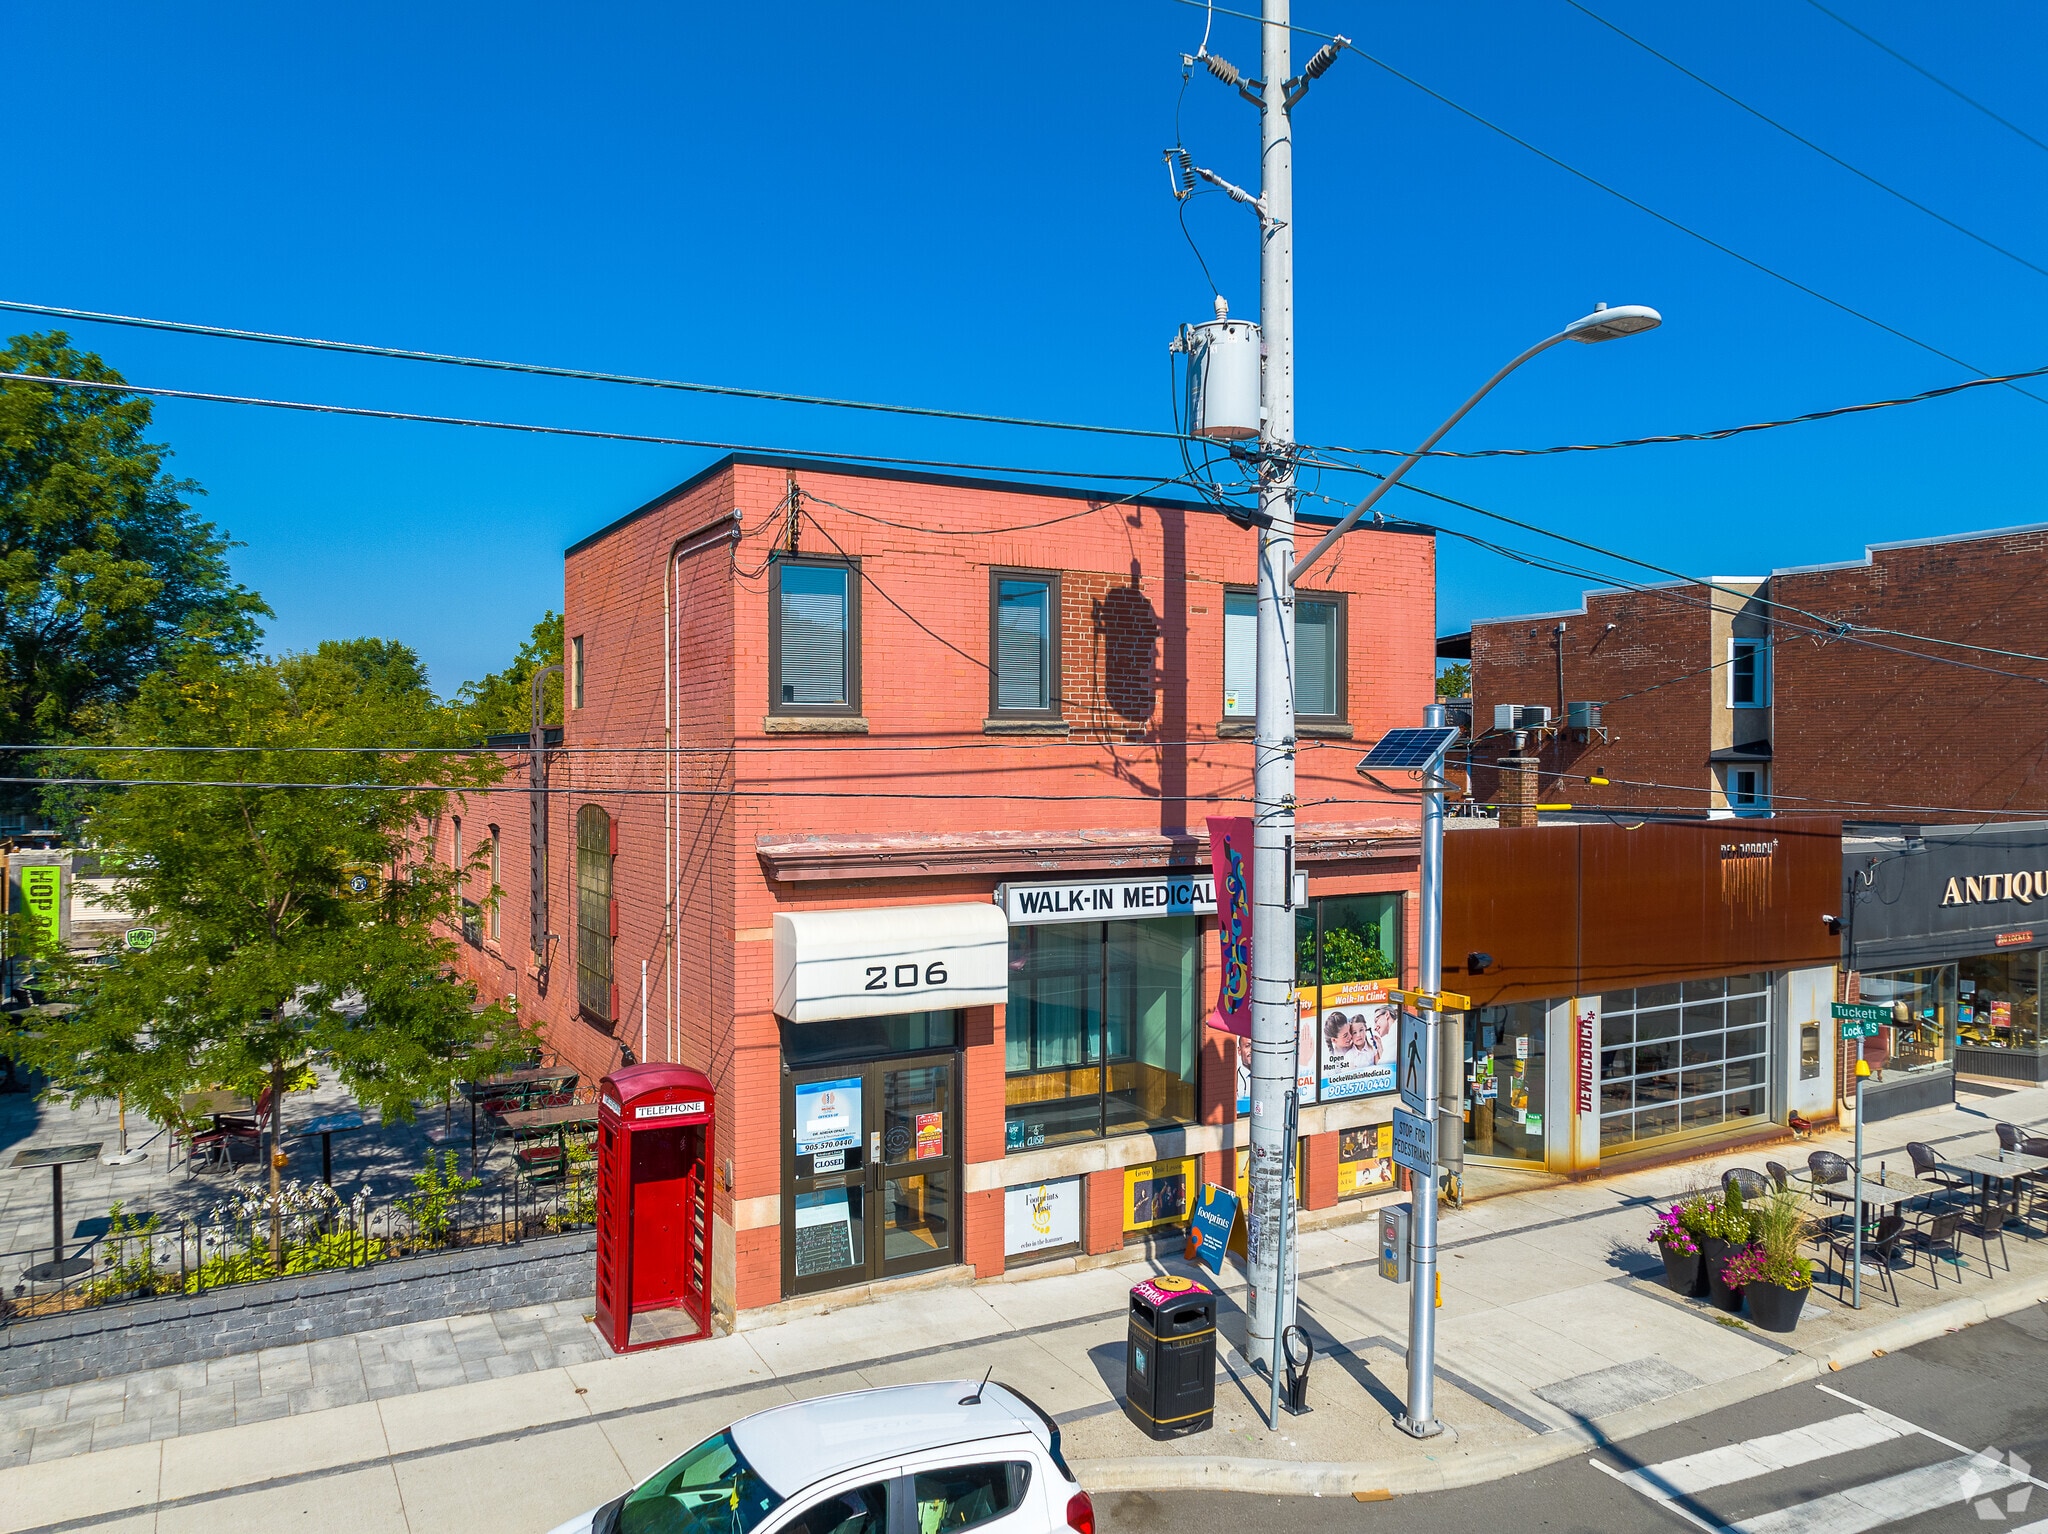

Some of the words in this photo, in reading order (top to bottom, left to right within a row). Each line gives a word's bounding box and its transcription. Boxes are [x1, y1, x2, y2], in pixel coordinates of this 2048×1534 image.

[30, 870, 53, 911] HOP
[1019, 888, 1113, 914] WALK-IN
[1123, 883, 1217, 909] MEDICAL
[864, 961, 948, 990] 206
[1342, 983, 1370, 994] Medical
[1373, 982, 1378, 990] &
[1335, 994, 1365, 1005] Walk-In
[1366, 990, 1386, 1002] Clinic
[1836, 1005, 1878, 1020] Tuckett
[1871, 1022, 1877, 1034] S
[1329, 1055, 1344, 1063] Open
[1328, 1078, 1391, 1098] 905.570.0440
[638, 1103, 701, 1116] TELEPHONE
[1398, 1121, 1413, 1138] STOP
[1415, 1127, 1426, 1144] FOR
[805, 1139, 853, 1151] 905.570.0440
[1394, 1138, 1430, 1165] PEDESTRIANS
[814, 1158, 844, 1169] CLOSED
[1135, 1169, 1150, 1177] Group
[1025, 1193, 1059, 1205] Footprints
[1032, 1203, 1052, 1214] Music
[1197, 1206, 1230, 1228] footprints
[1178, 1337, 1203, 1347] LITTER
